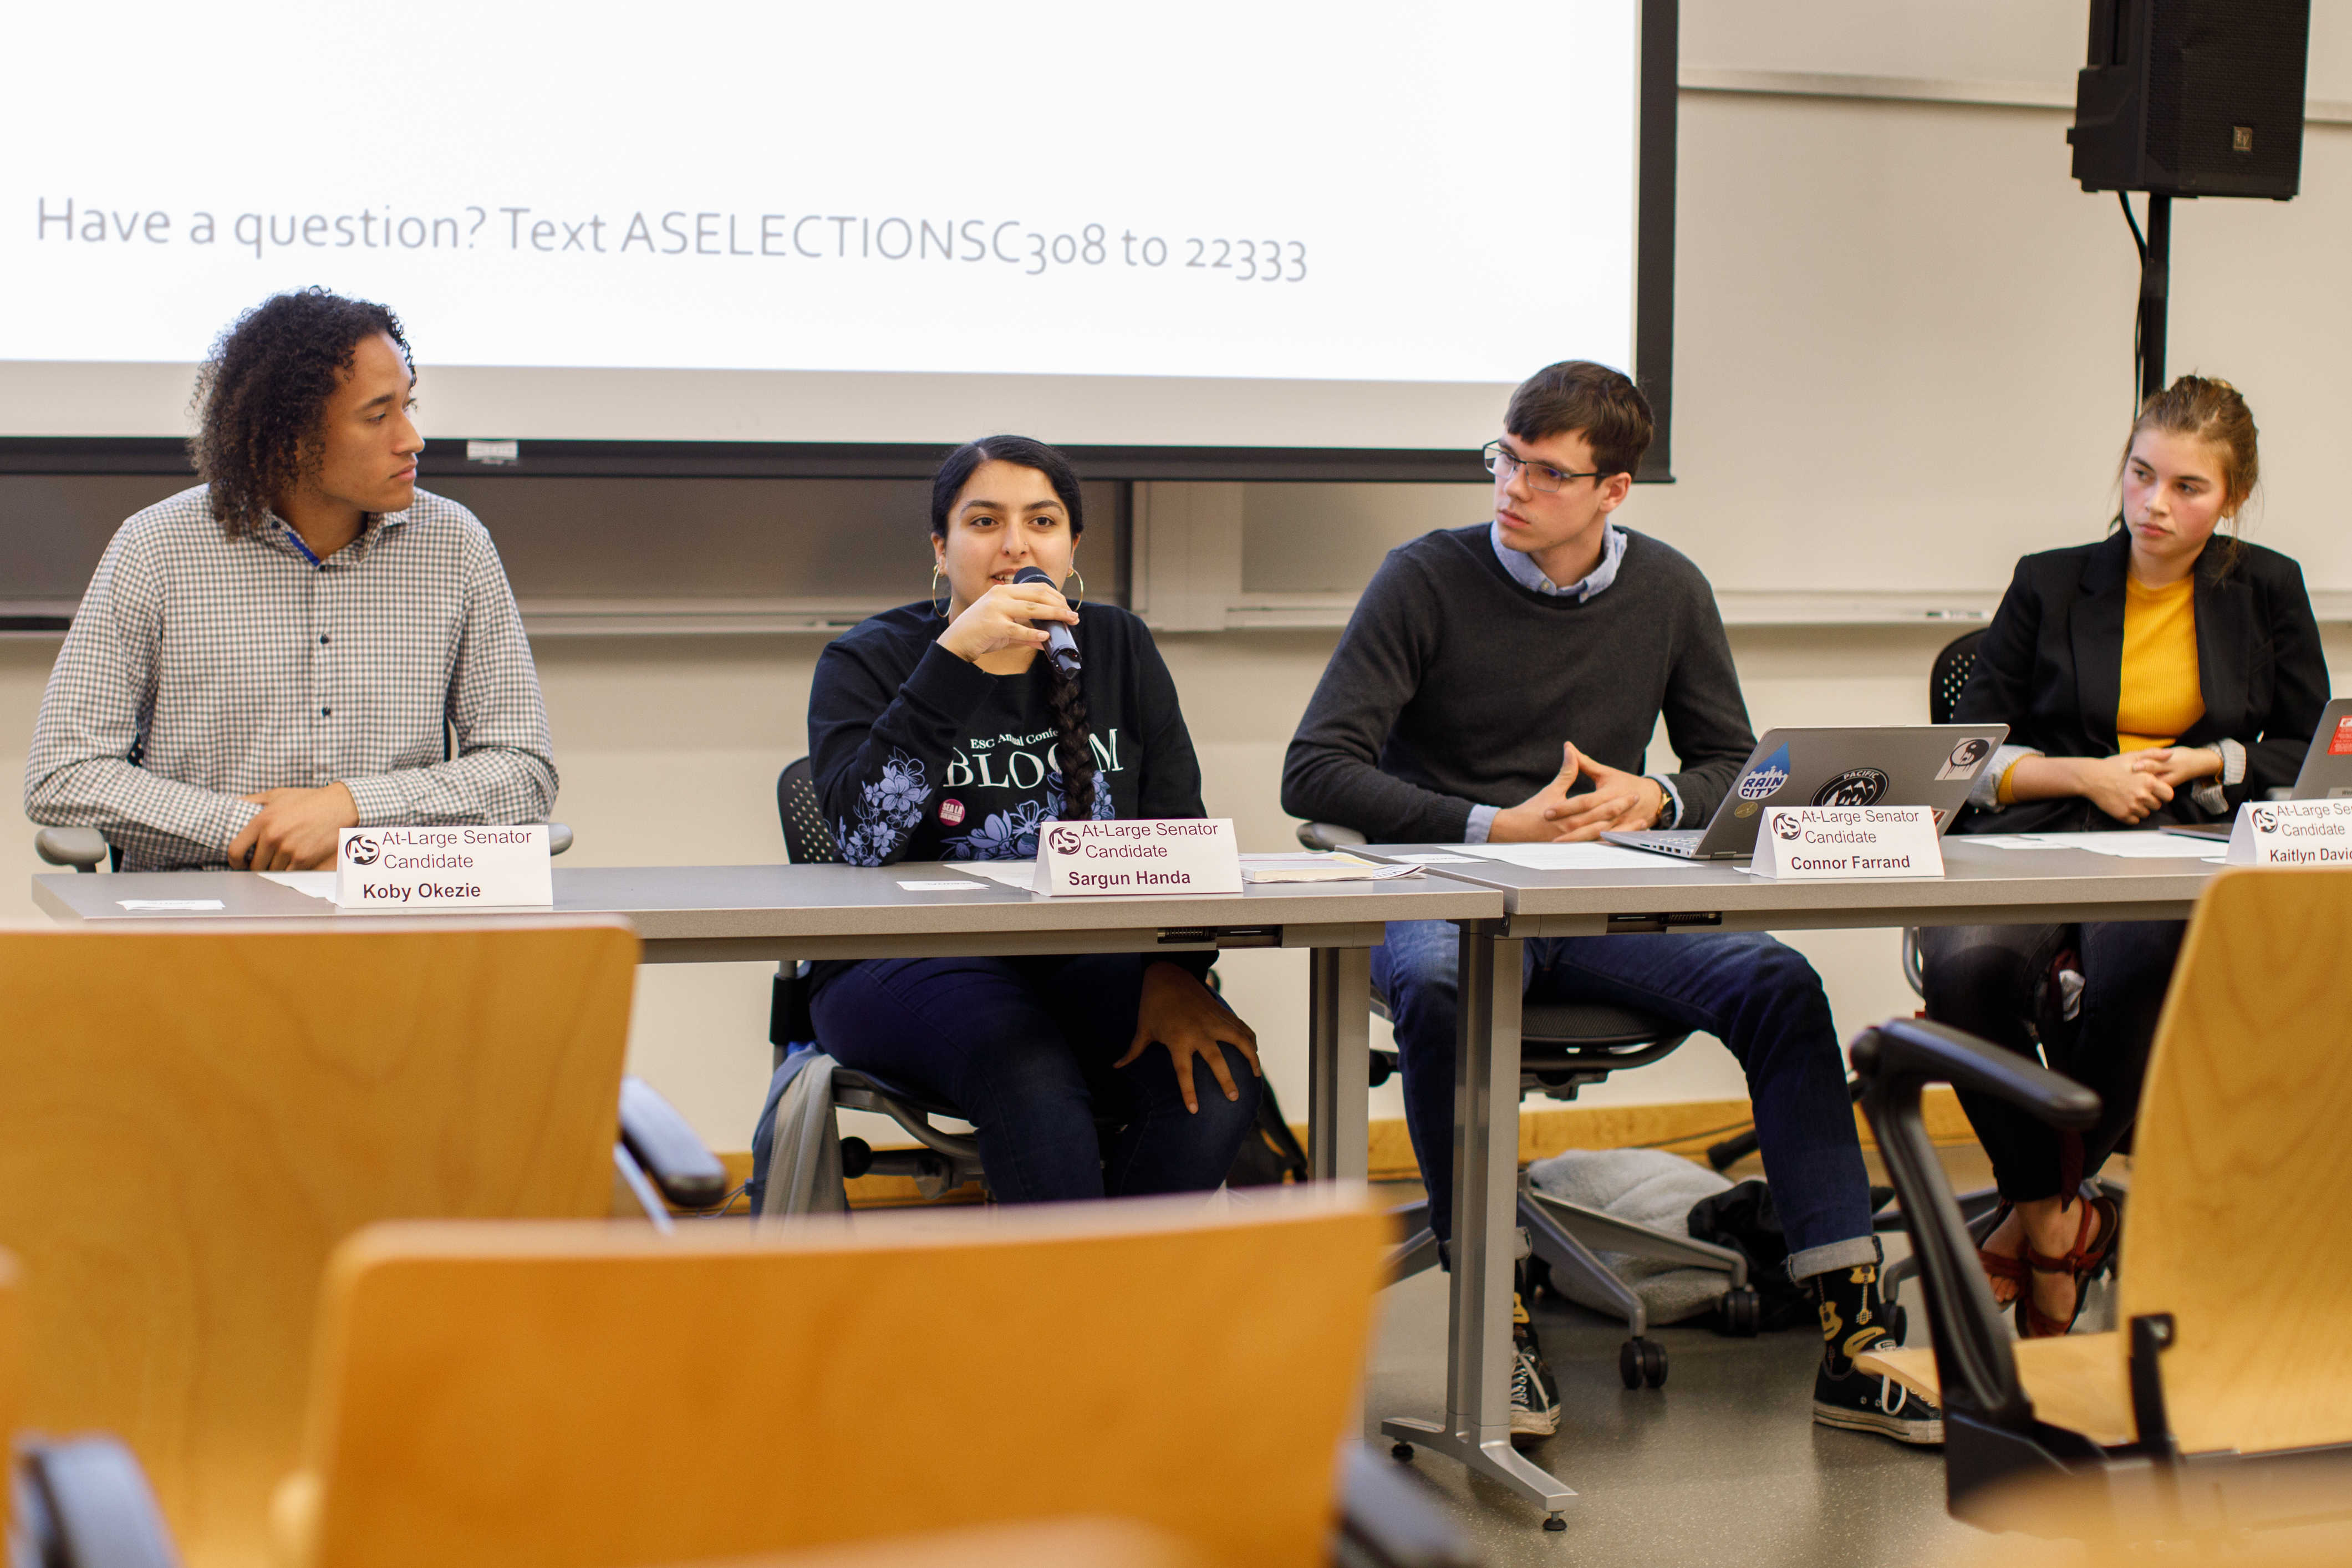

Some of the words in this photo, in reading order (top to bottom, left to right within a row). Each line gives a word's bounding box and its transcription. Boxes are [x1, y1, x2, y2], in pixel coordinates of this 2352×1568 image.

[38, 196, 171, 244] Have
[190, 211, 215, 245] a
[234, 205, 486, 259] question?
[499, 207, 607, 253] Text
[620, 211, 1106, 276] ASELECTIONSC308
[1121, 228, 1168, 268] to
[1185, 237, 1307, 283] 22333
[970, 738, 996, 750] ESC
[1743, 777, 1784, 787] RAIN
[1844, 770, 1880, 780] PACIFIC
[1741, 787, 1778, 798] CITY
[1801, 810, 1861, 826] At-Large
[1865, 809, 1920, 823] Senator
[2277, 805, 2330, 819] At-Large
[1082, 824, 1151, 839] At-Large
[1155, 822, 1218, 836] Senator
[1805, 829, 1877, 844] Candidate
[2282, 823, 2345, 837] Candidate
[382, 831, 457, 848] At-Large
[464, 829, 532, 844] Senator
[1085, 844, 1168, 858] Candidate
[2269, 848, 2315, 864] Kaitlyn
[384, 853, 474, 869] Candidate
[1790, 856, 1847, 870] Connor
[1851, 855, 1911, 869] Farrand
[1068, 870, 1131, 889] Sargun
[1136, 870, 1192, 885] Handa
[363, 883, 411, 903] Koby
[418, 882, 481, 898] Okezie
